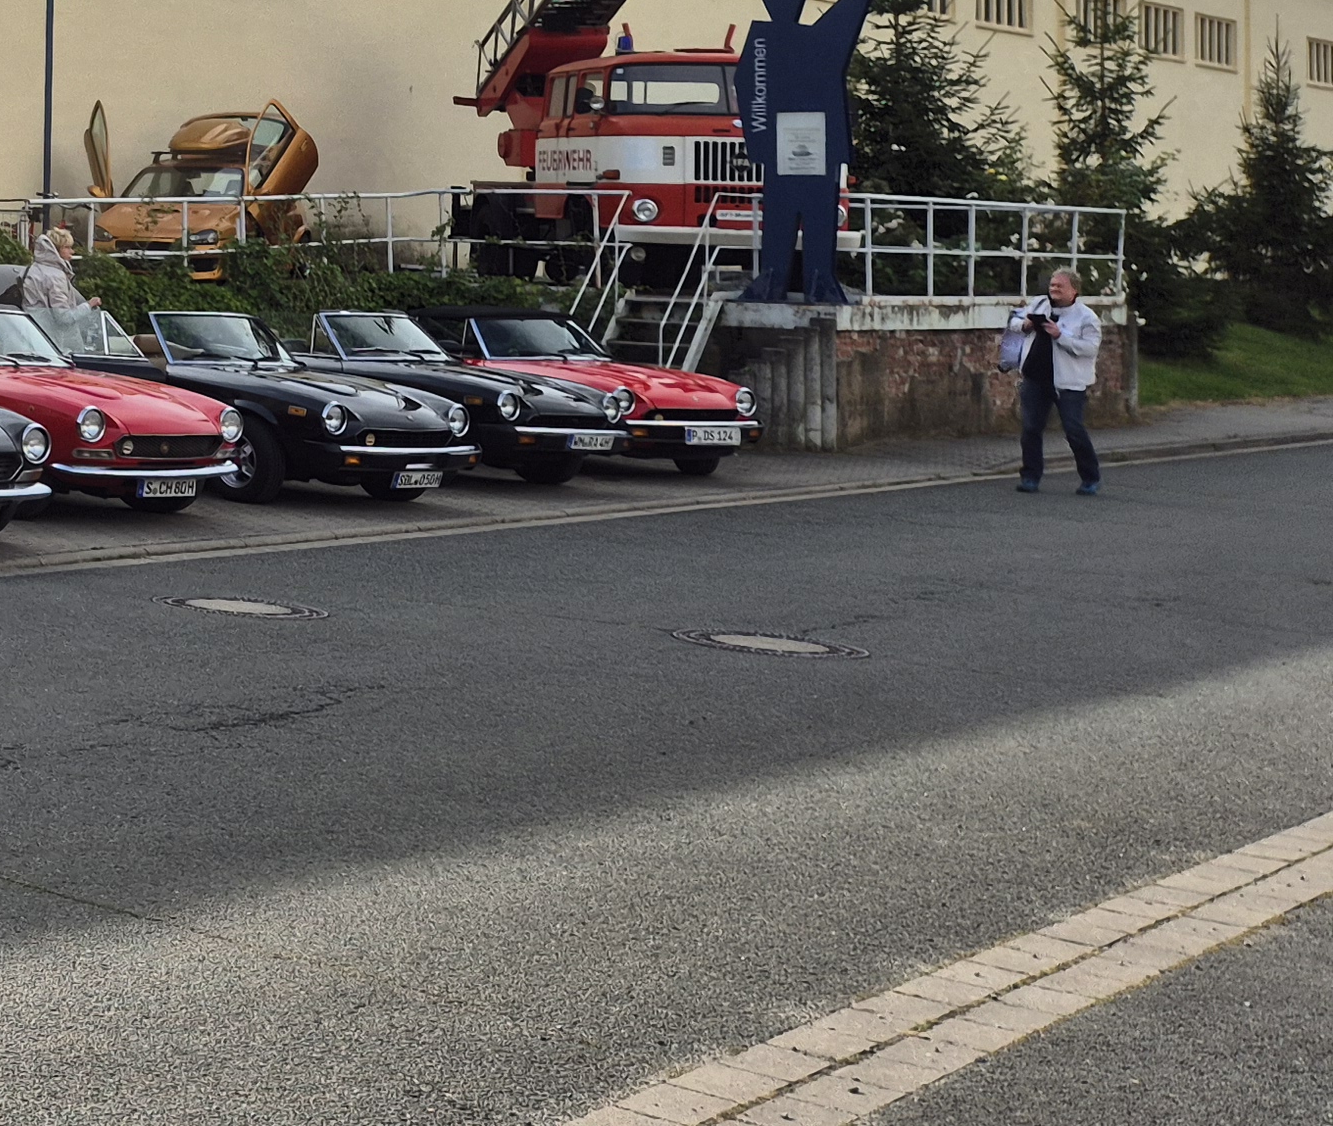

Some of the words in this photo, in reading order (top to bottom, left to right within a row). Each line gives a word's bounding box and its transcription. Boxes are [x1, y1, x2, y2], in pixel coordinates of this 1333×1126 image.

[751, 38, 767, 132] Willkommen
[538, 149, 592, 171] FEUERWEHR
[145, 481, 153, 494] S
[159, 481, 173, 494] CH
